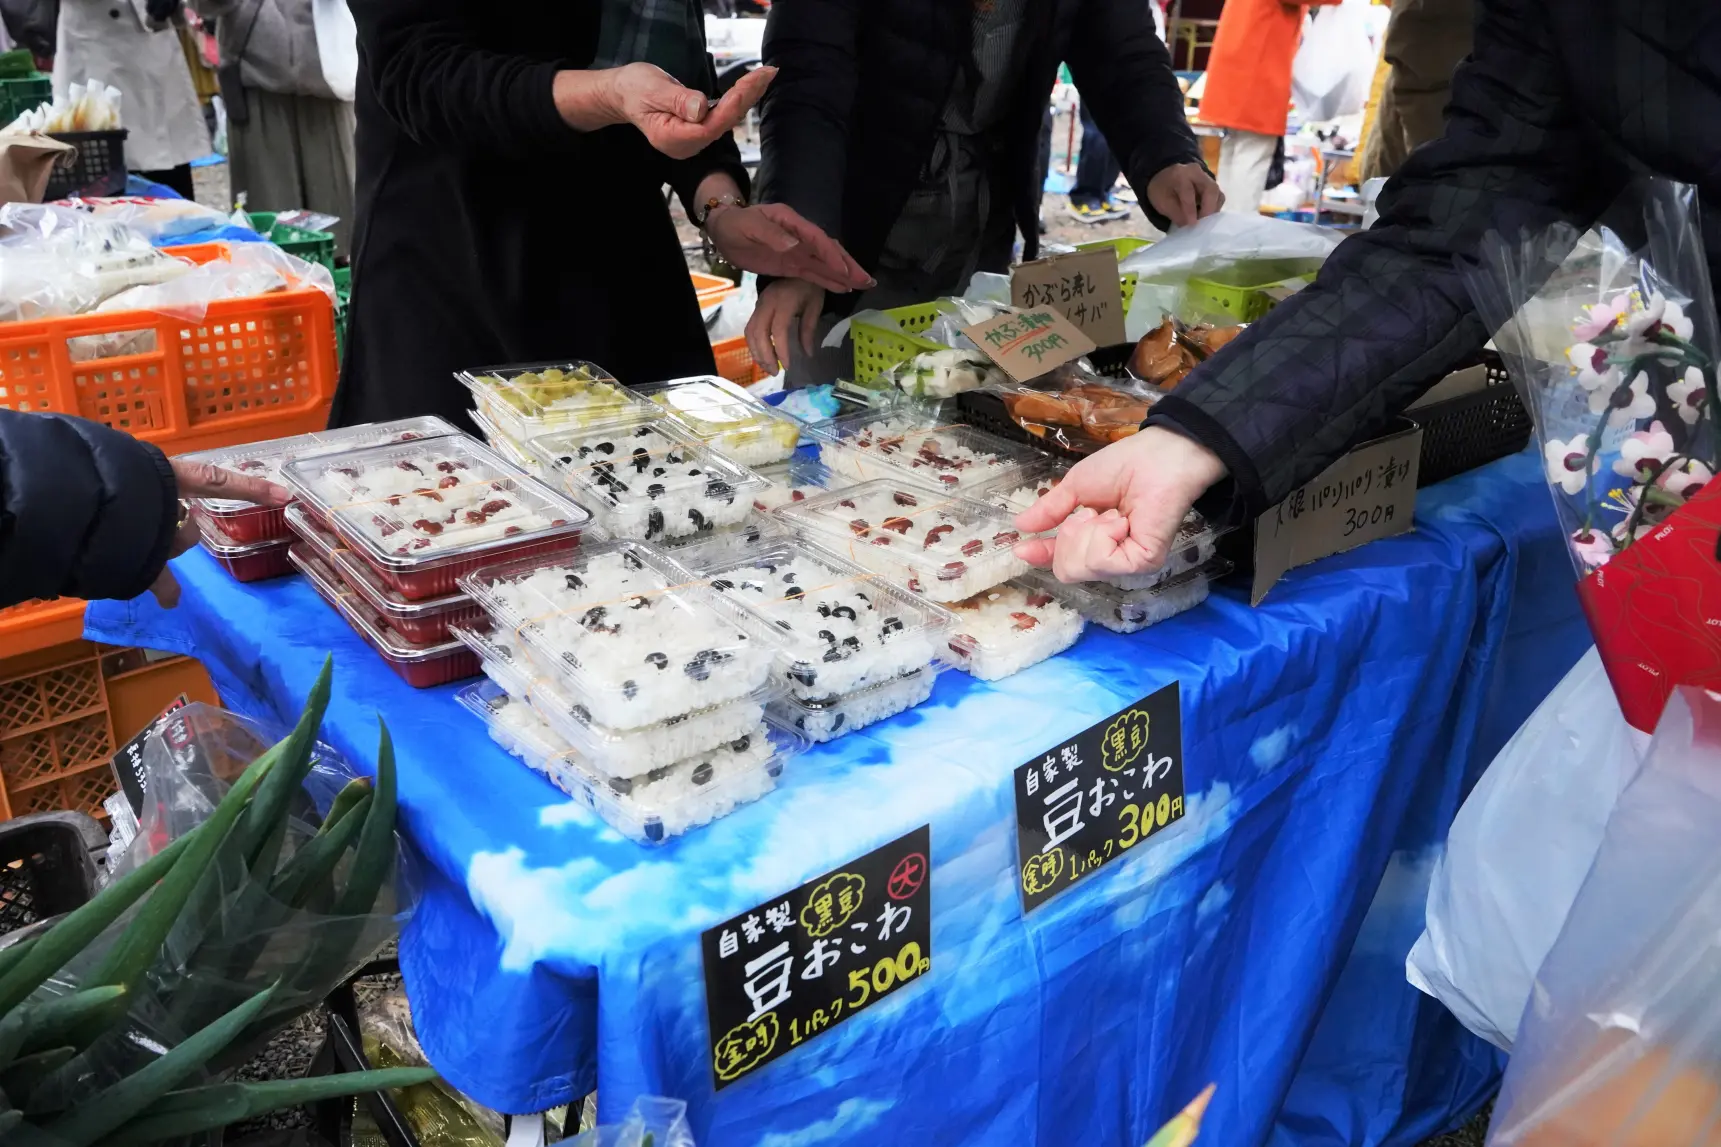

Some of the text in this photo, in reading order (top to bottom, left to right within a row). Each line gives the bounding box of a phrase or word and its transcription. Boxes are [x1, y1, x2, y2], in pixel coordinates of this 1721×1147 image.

[1022, 271, 1096, 309] かぶら寿し
[1654, 524, 1675, 541] PILOT
[1706, 617, 1721, 627] LOT
[1110, 724, 1142, 762] 黒豆
[1026, 743, 1083, 796] 自家製
[1042, 752, 1173, 853] 豆おこわ
[891, 860, 920, 896] 大
[814, 885, 854, 926] 黒豆
[719, 900, 797, 959] 自家製
[743, 901, 912, 1023] 豆おこわ
